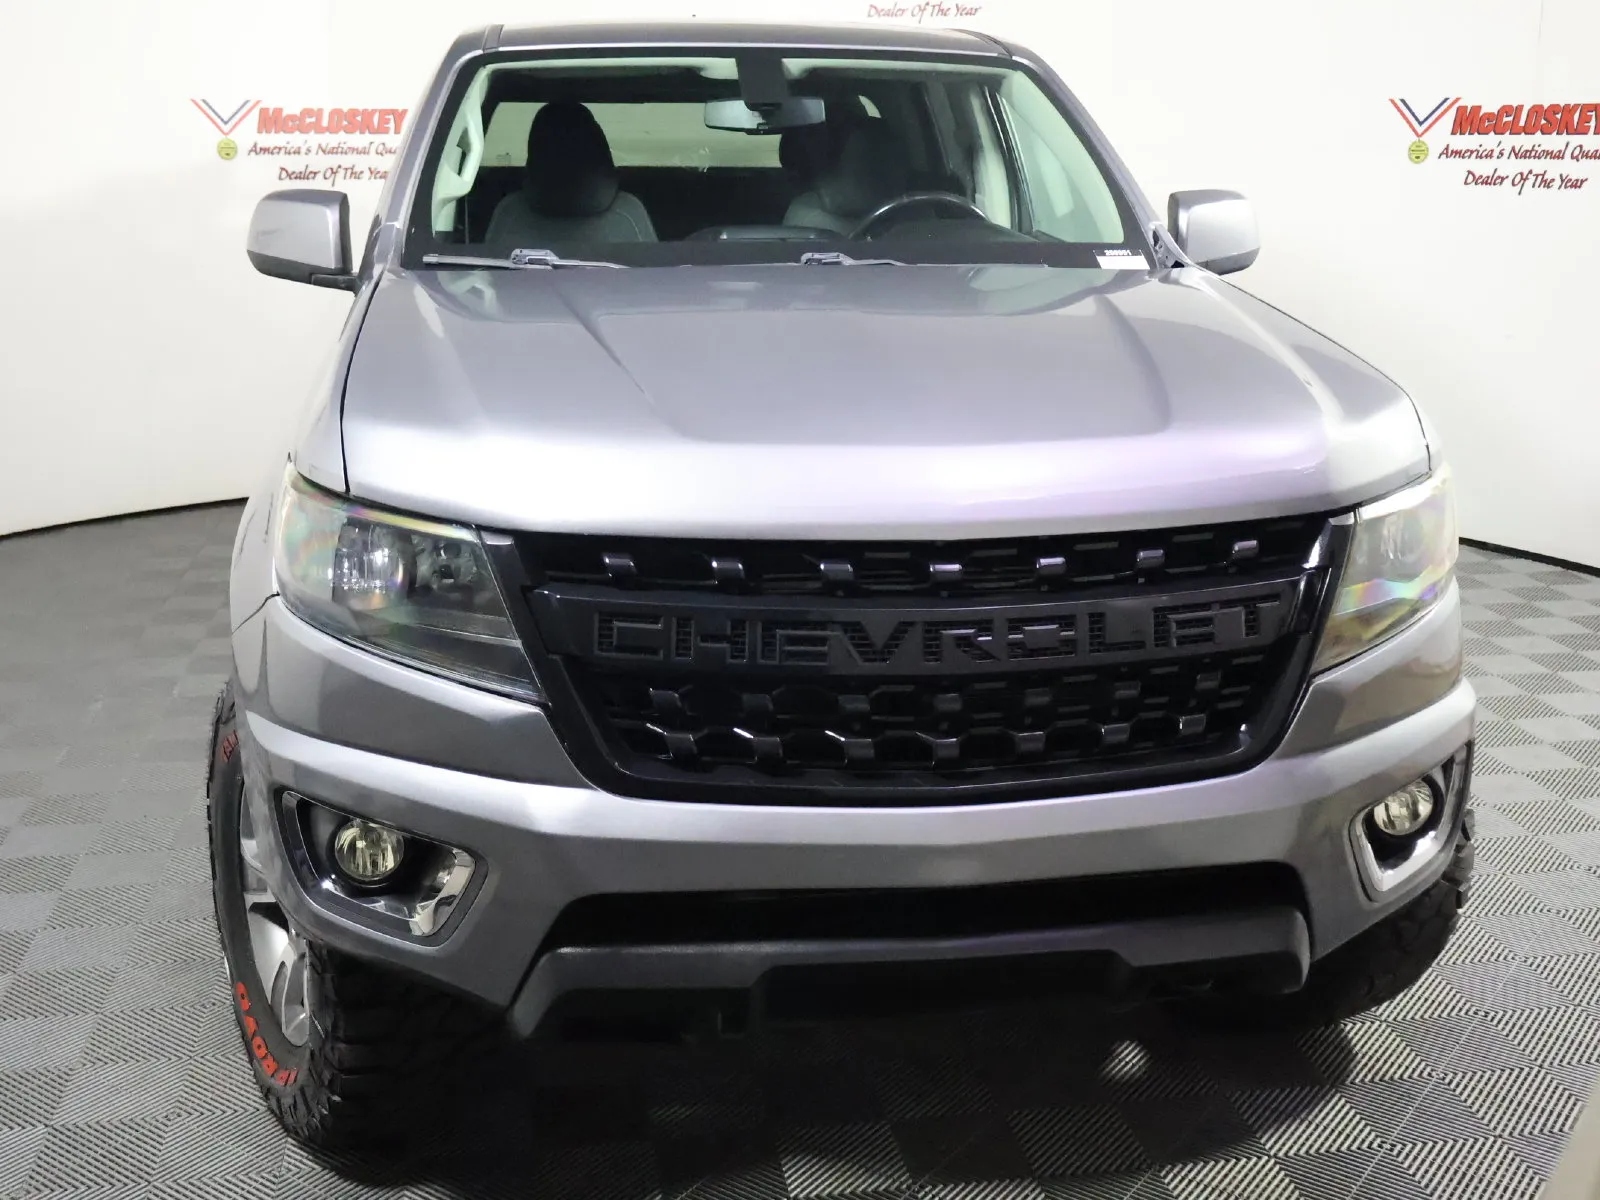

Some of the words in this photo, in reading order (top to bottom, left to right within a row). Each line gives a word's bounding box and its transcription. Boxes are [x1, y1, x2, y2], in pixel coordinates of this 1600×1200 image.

[867, 1, 908, 18] Dealer
[911, 0, 930, 24] Of
[930, 1, 951, 17] The
[954, 2, 982, 17] Year
[257, 107, 408, 134] McCLOSKEY
[247, 140, 311, 157] America's
[317, 141, 374, 156] National
[1438, 140, 1505, 160] America's
[1507, 141, 1570, 160] National
[278, 164, 321, 181] Dealer
[323, 165, 342, 187] Of
[343, 165, 364, 181] The
[368, 166, 389, 181] Yea
[1464, 168, 1510, 187] Dealer
[1511, 169, 1533, 196] Of
[1532, 170, 1555, 190] The
[1558, 173, 1588, 190] Year
[594, 594, 1282, 667] CHEVROLET
